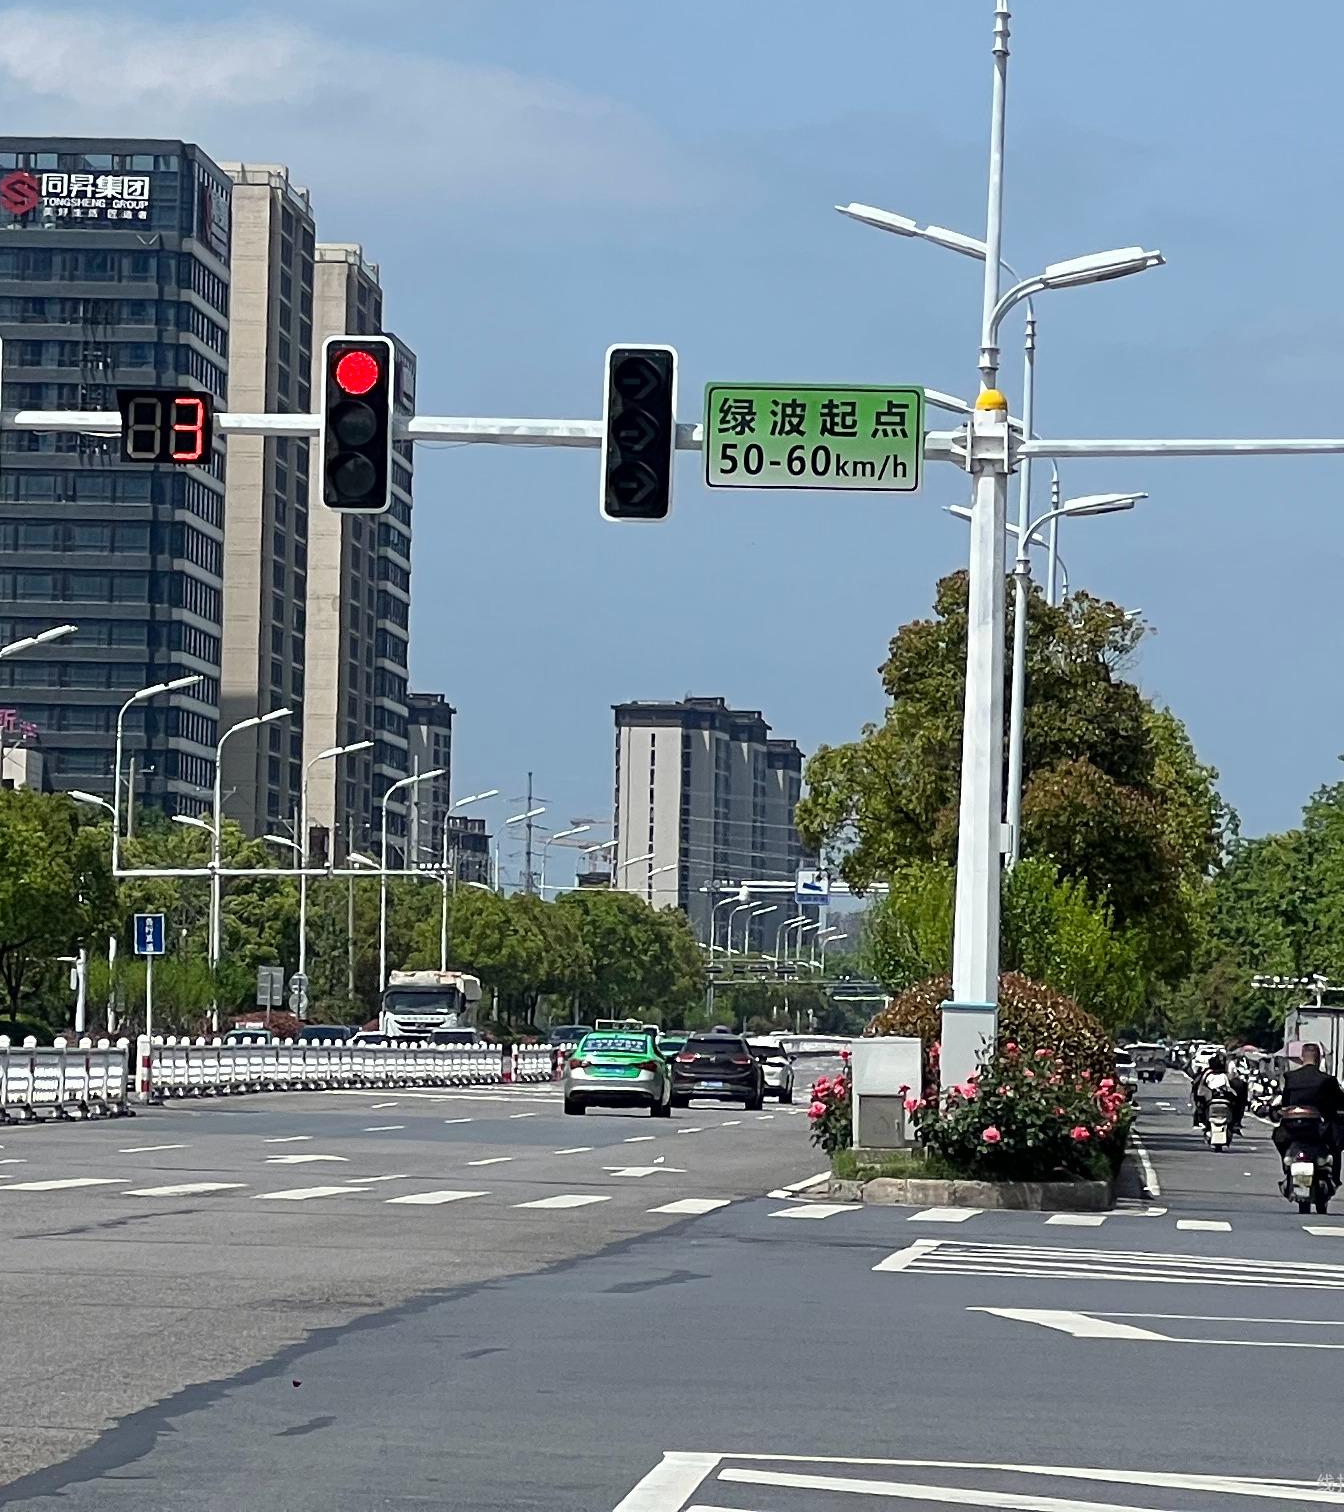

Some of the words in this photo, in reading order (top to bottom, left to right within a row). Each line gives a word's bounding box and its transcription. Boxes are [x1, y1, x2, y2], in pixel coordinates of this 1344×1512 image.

[42, 173, 150, 199] 同昇集团
[43, 197, 106, 208] TONGSHENG
[112, 199, 149, 210] GROUP
[717, 397, 910, 439] 绿波起点
[719, 443, 907, 481] 50-60km/h
